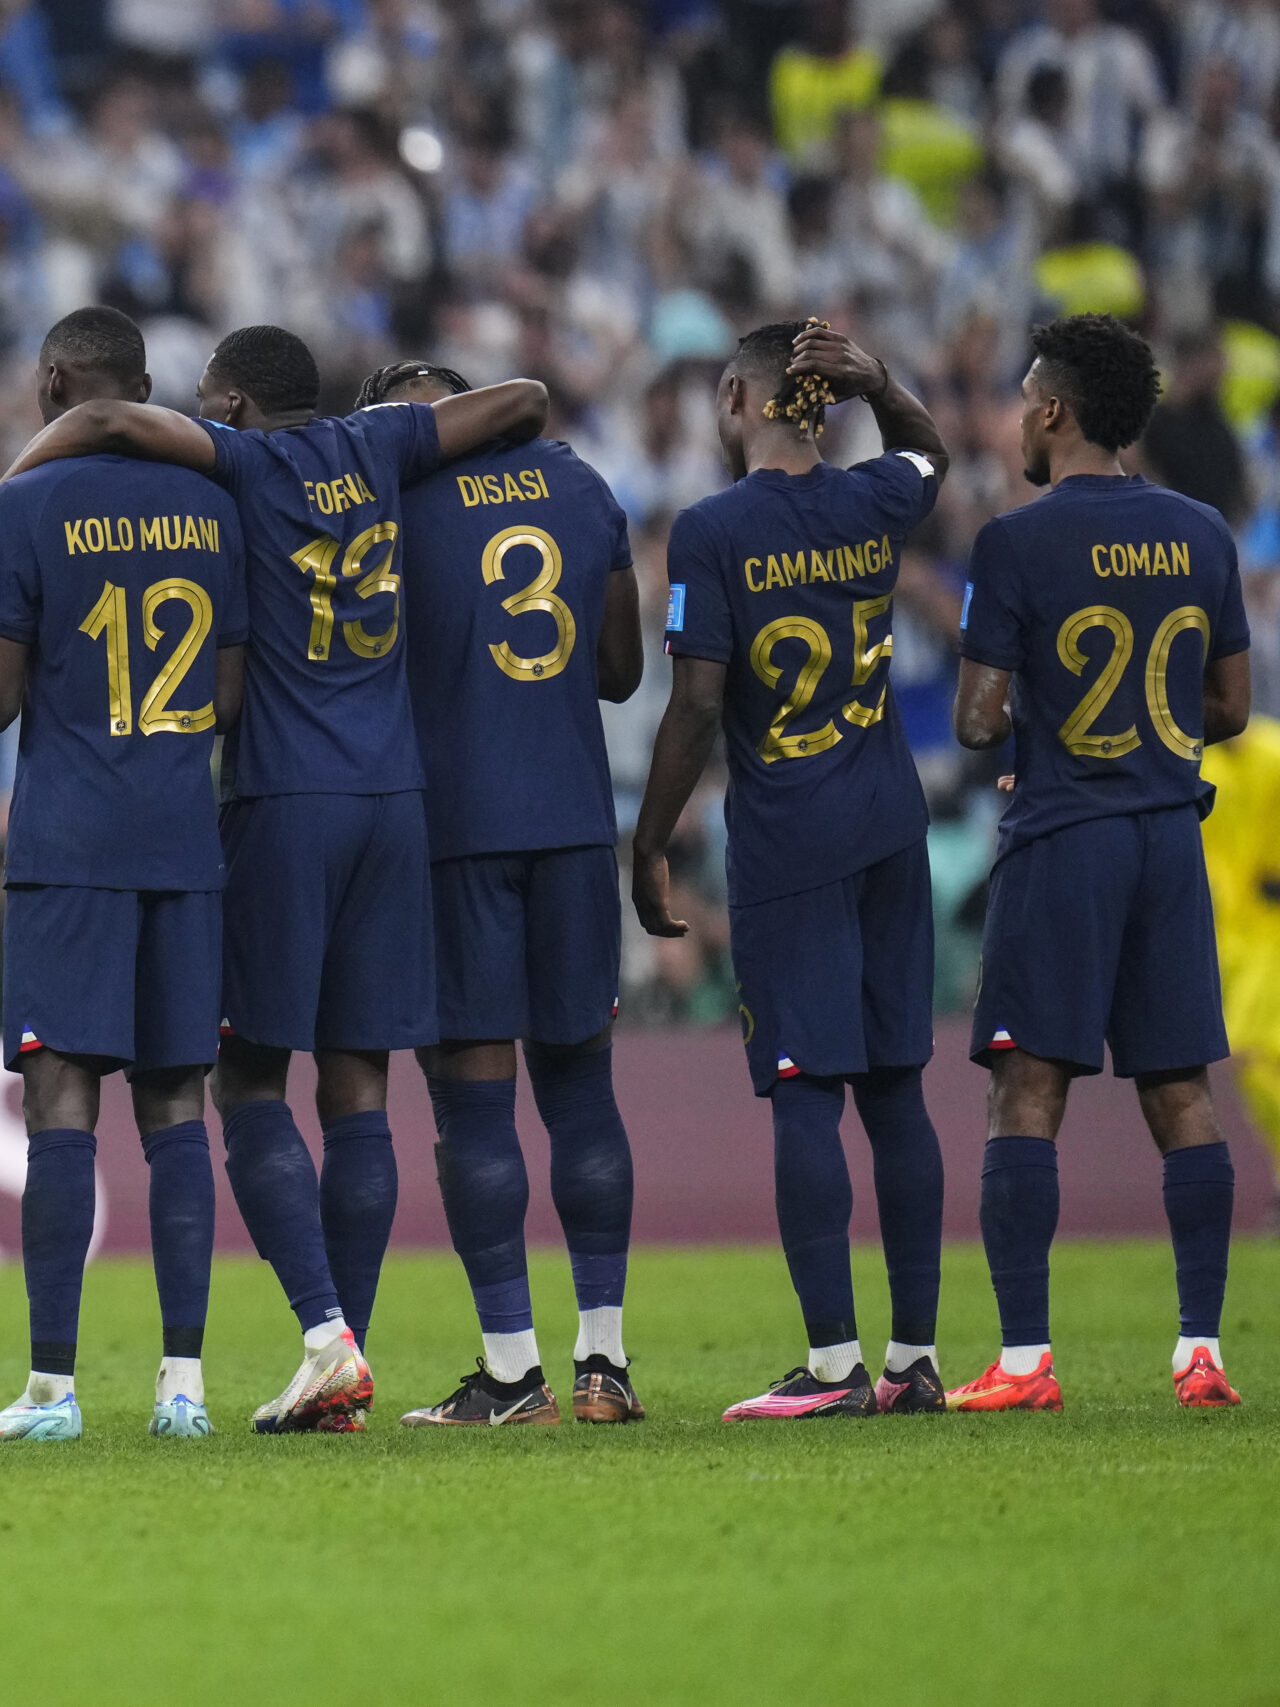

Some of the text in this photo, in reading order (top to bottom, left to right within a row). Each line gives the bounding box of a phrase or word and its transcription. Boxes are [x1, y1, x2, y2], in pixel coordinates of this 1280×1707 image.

[64, 515, 220, 555] KOLO MUANI
[456, 468, 550, 507] DISASI
[1091, 541, 1191, 577] COMAN
[78, 577, 217, 737] 12
[289, 520, 401, 661] 13
[481, 525, 576, 682] 3
[750, 591, 894, 765] 25
[1056, 605, 1211, 761] 20
